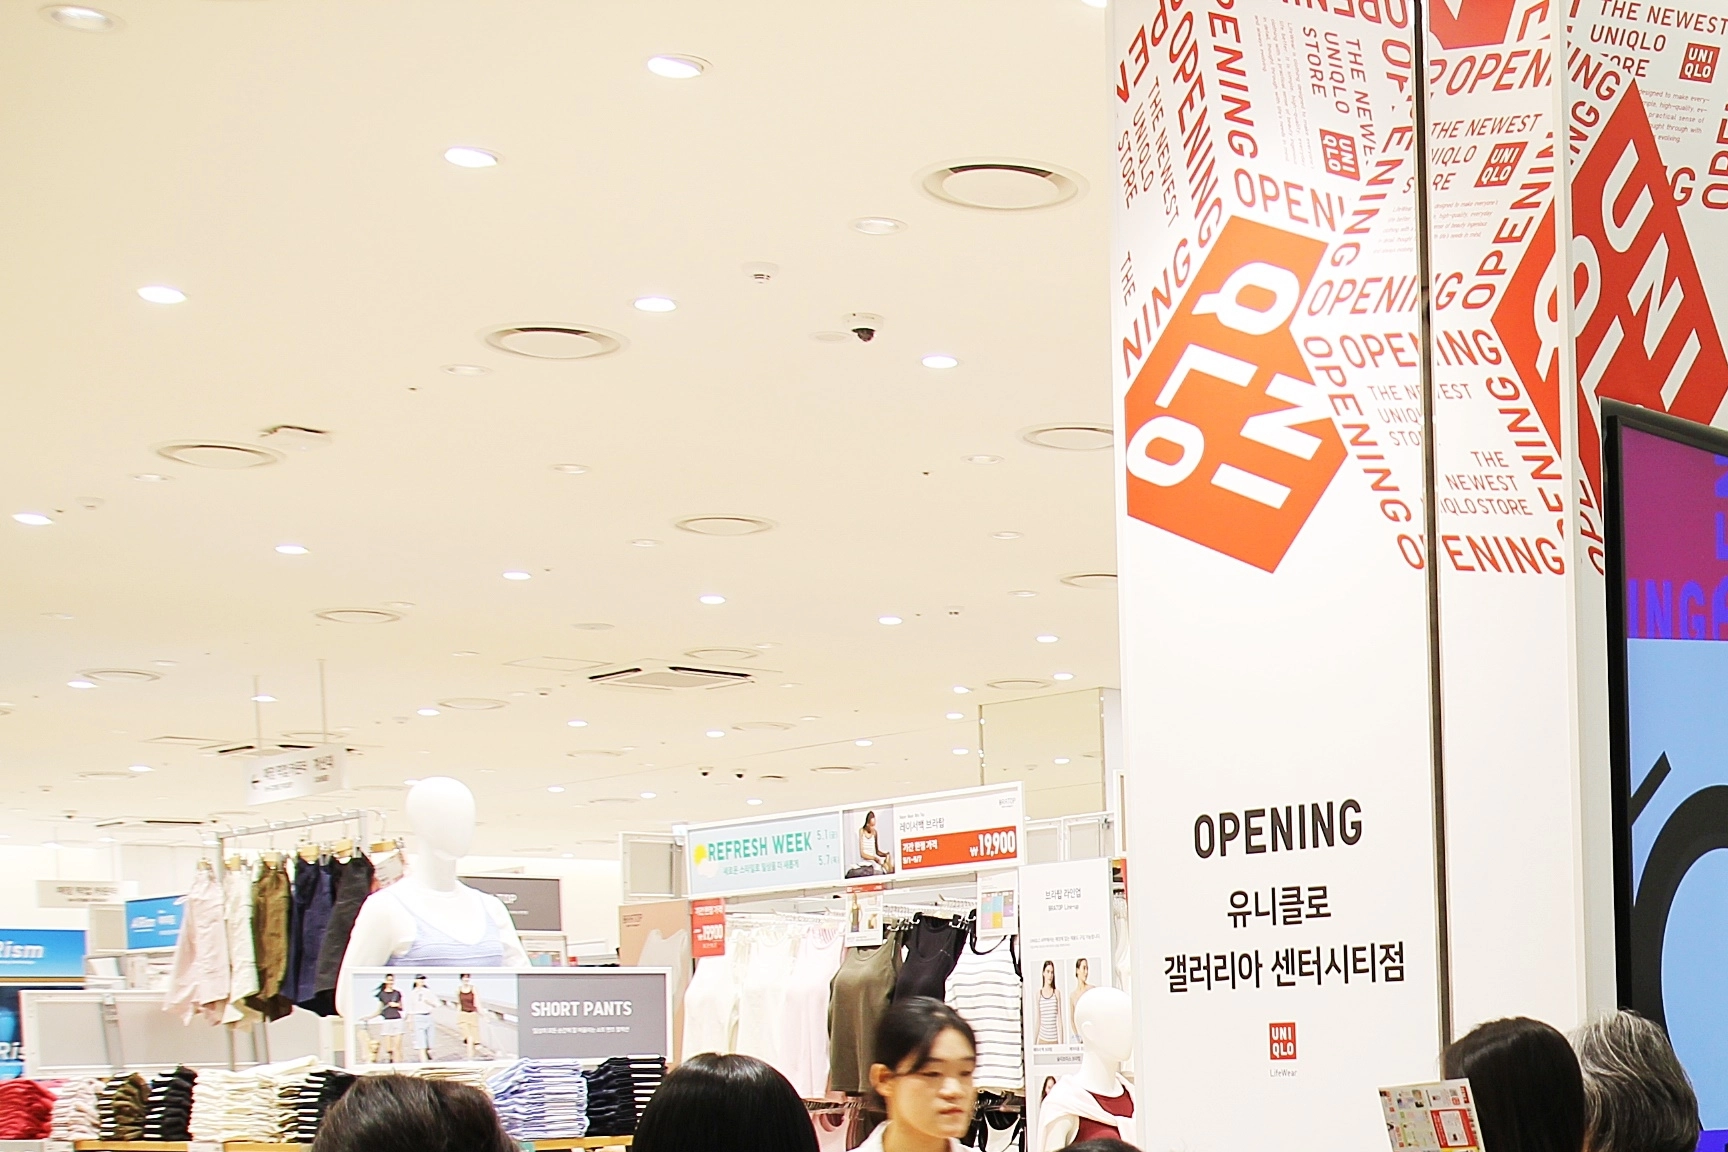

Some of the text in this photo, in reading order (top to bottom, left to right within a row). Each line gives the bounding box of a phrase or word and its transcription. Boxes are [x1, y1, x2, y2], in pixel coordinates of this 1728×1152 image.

[1600, 1, 1641, 22] THE
[1590, 24, 1667, 53] UNIQLO
[1303, 26, 1327, 98] STORE
[1346, 39, 1367, 83] THE
[1687, 47, 1713, 63] UNI
[1324, 31, 1350, 114] UNIQLO
[1684, 63, 1712, 80] QLO
[1169, 11, 1223, 248] OPENING
[1431, 113, 1544, 140] THE NEWEST
[1133, 102, 1154, 193] UNIQLO
[1148, 76, 1180, 228] THE NEWEST
[1491, 148, 1519, 163] UNI
[1117, 130, 1139, 209] STORE
[1482, 166, 1512, 183] QLO
[1120, 250, 1137, 307] THE
[1367, 385, 1403, 401] THE
[1304, 336, 1412, 524] OPENING
[1471, 451, 1509, 468] THE
[1447, 475, 1518, 491] NEWEST
[1397, 534, 1565, 575] OENING
[1193, 798, 1362, 860] OPENING
[708, 831, 813, 862] REFRESH WEEK
[1227, 885, 1332, 929] 유니클로
[1164, 941, 1405, 994] 갤러리아 센터시티점
[531, 1000, 633, 1017] SHORT PANTS
[1271, 1026, 1293, 1040] UNI
[1272, 1042, 1295, 1059] QLO
